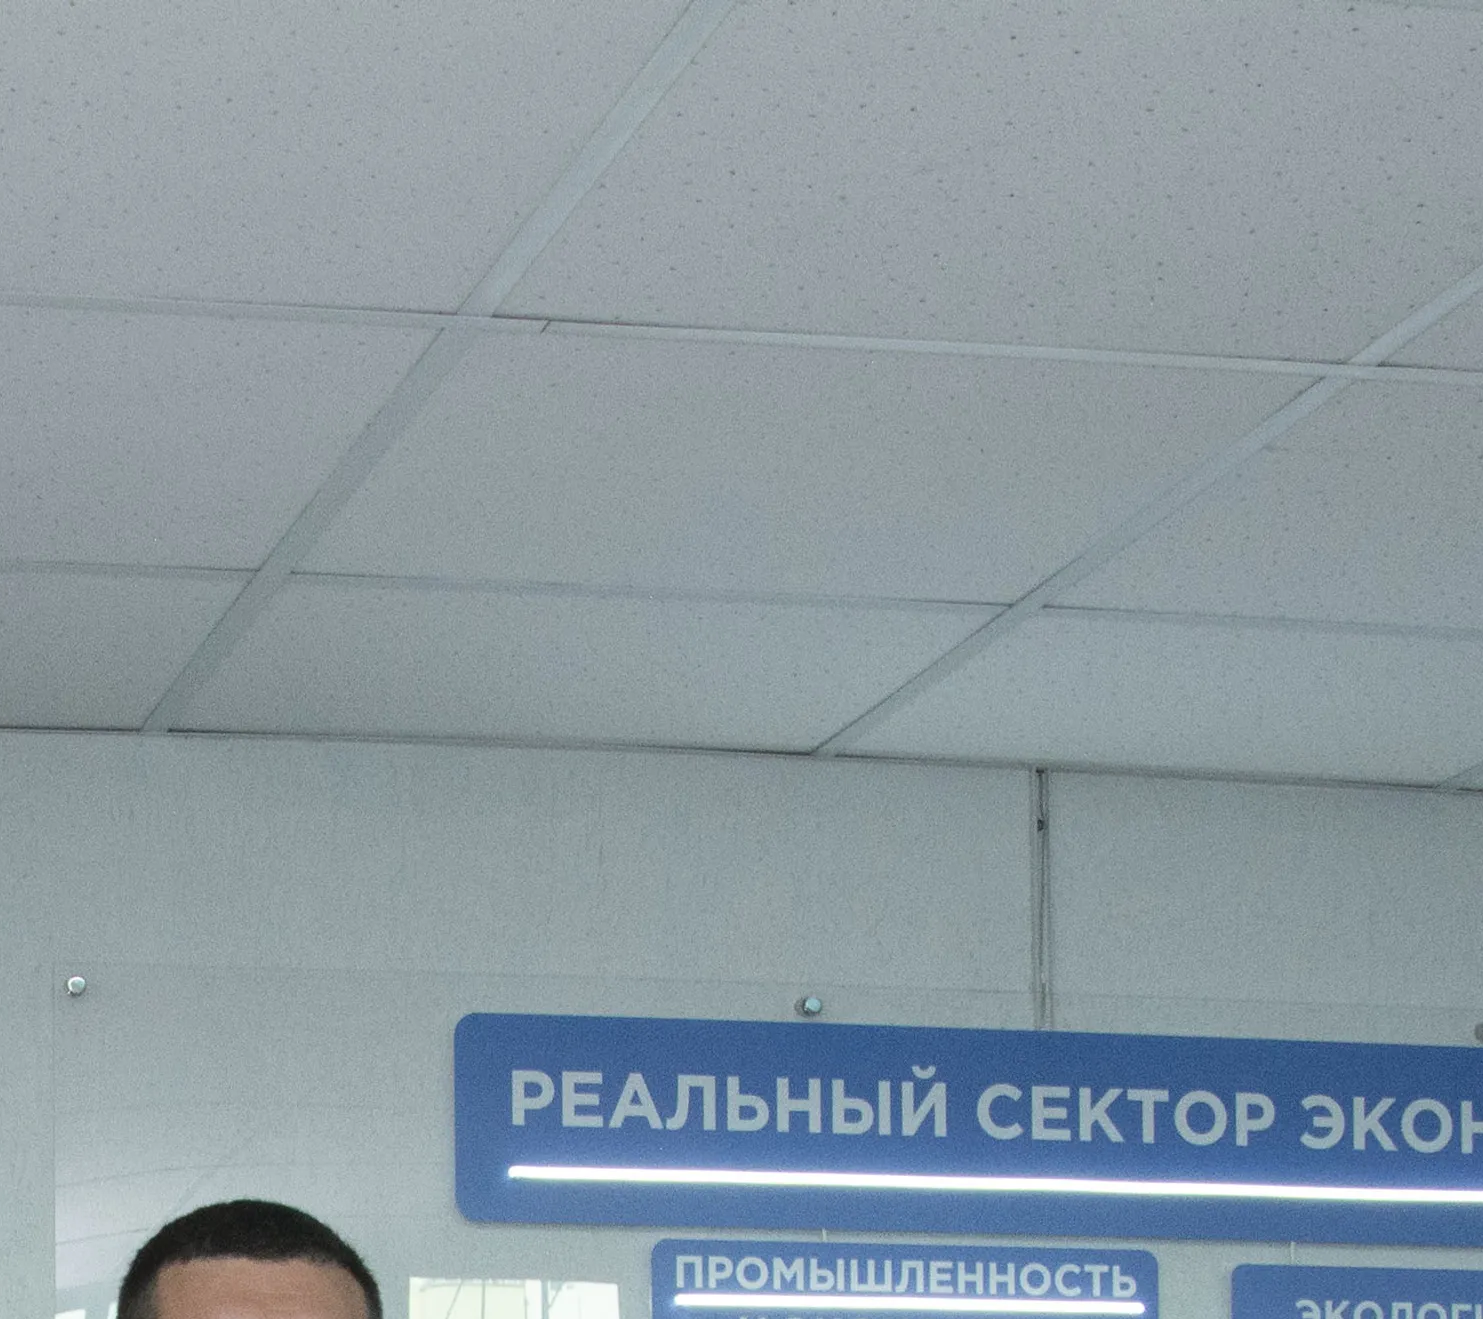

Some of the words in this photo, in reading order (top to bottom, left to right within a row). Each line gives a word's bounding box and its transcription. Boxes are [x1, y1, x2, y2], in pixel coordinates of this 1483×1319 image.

[511, 1065, 948, 1136] РЕАЛЬНЫЙ
[977, 1083, 1275, 1146] СЕКТОР
[676, 1255, 1137, 1298] ПРОМЫШЛЕННОСТЬ
